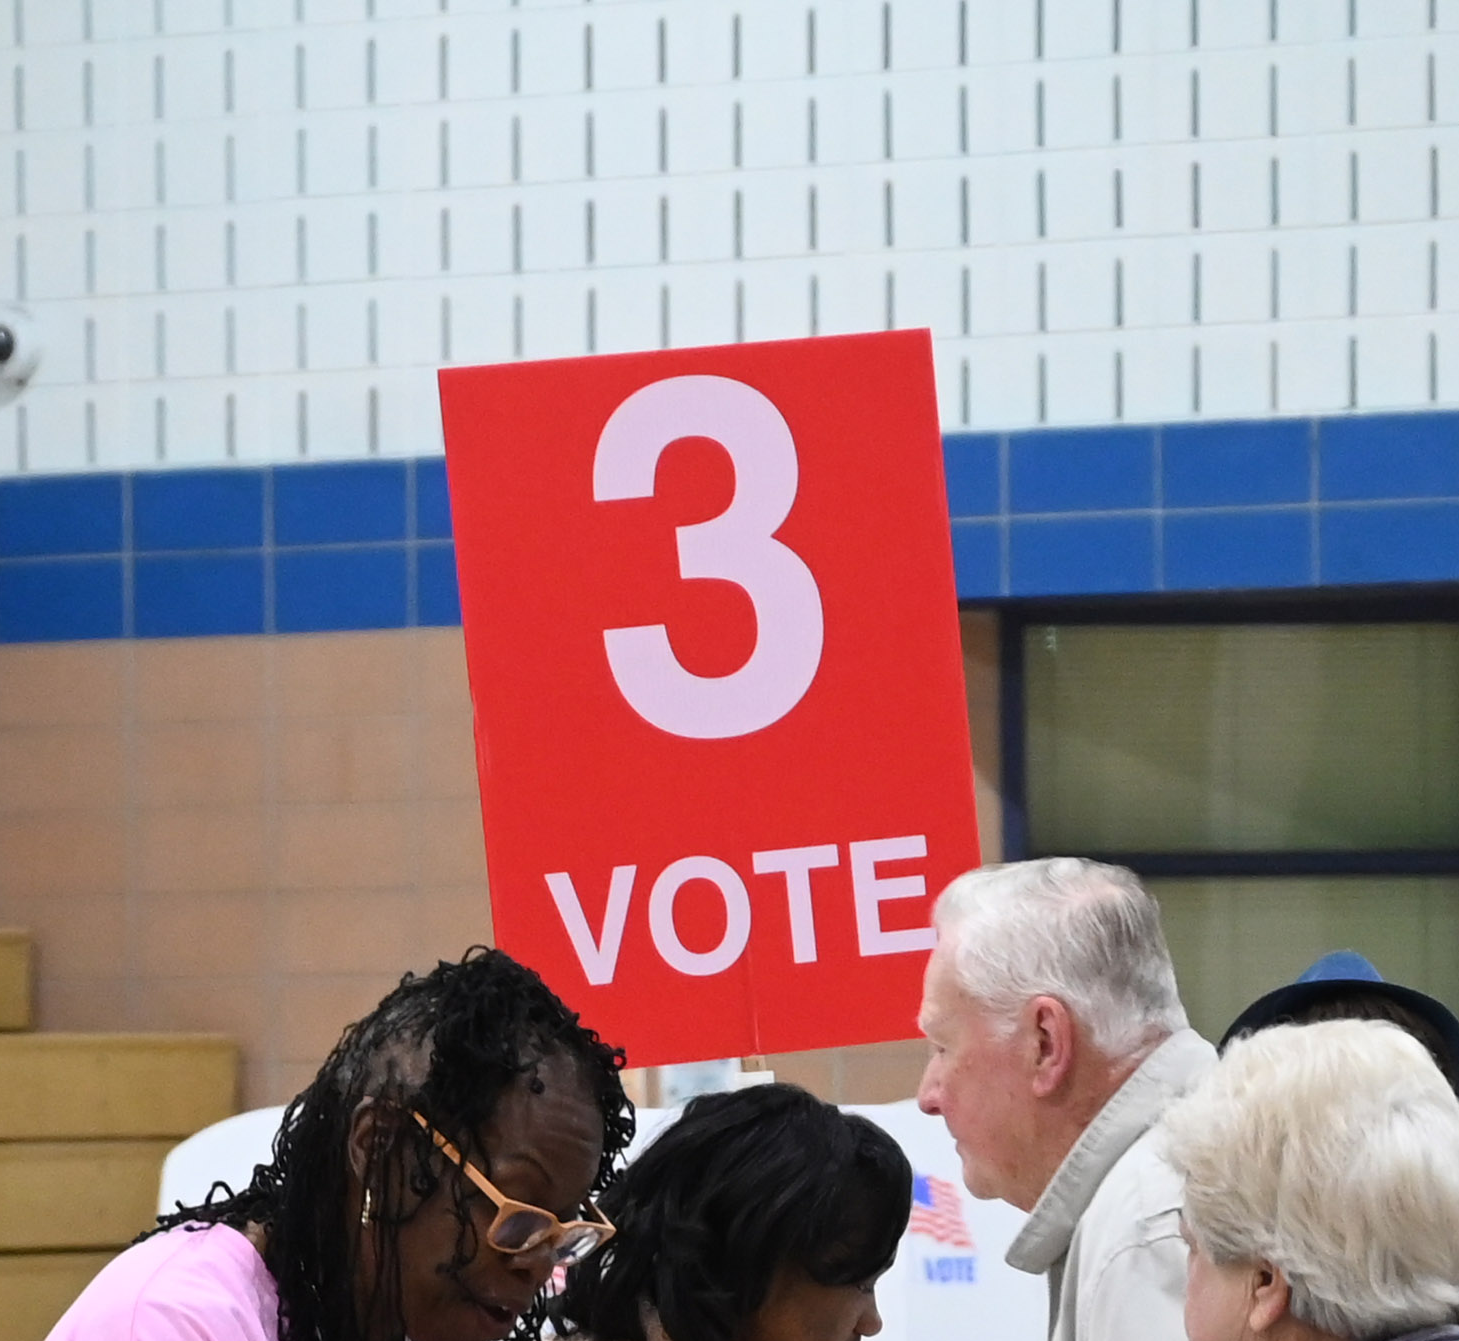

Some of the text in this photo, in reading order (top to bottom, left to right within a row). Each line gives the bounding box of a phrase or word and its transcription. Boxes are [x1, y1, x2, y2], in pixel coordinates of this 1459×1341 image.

[592, 374, 824, 740] 3
[544, 834, 937, 986] VOTE
[925, 1256, 975, 1284] VOTE
